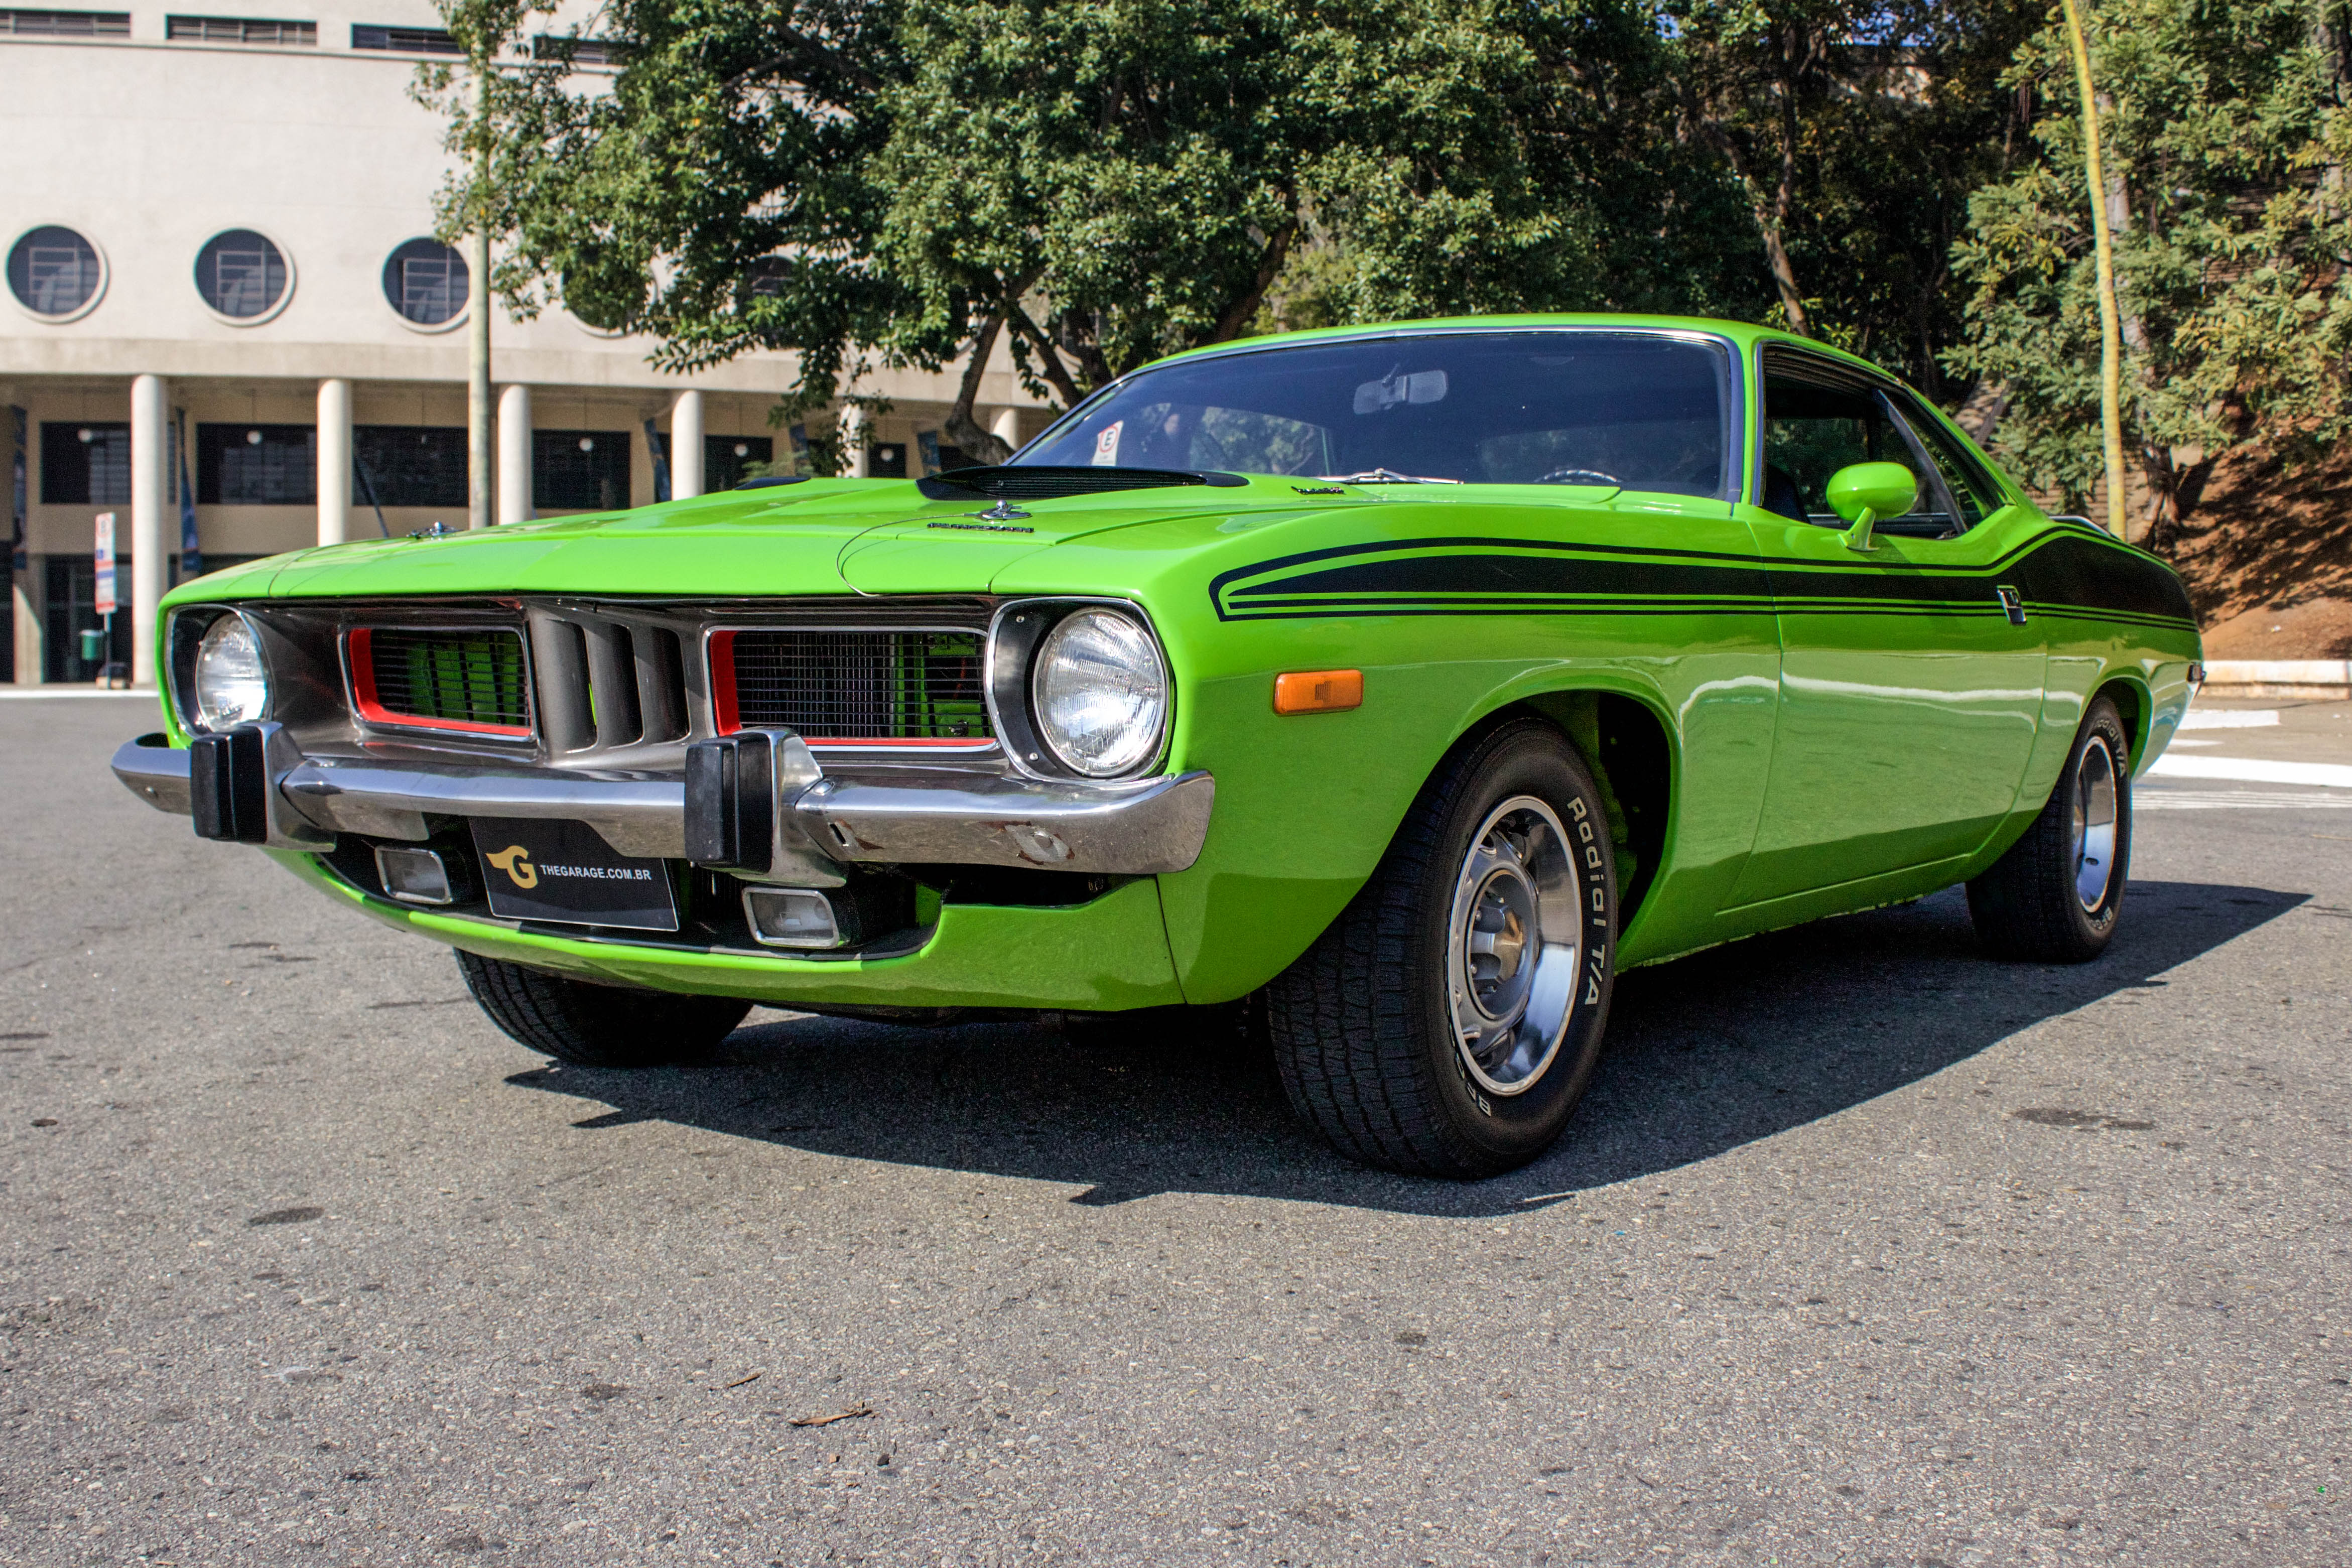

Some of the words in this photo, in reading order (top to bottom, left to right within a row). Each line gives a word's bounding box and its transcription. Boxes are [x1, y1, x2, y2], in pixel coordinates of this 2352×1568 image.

[1104, 431, 1114, 446] E
[540, 864, 652, 880] THEGARAGE.COM.BR
[1567, 797, 1606, 928] Radial
[1585, 944, 1605, 1005] T/A
